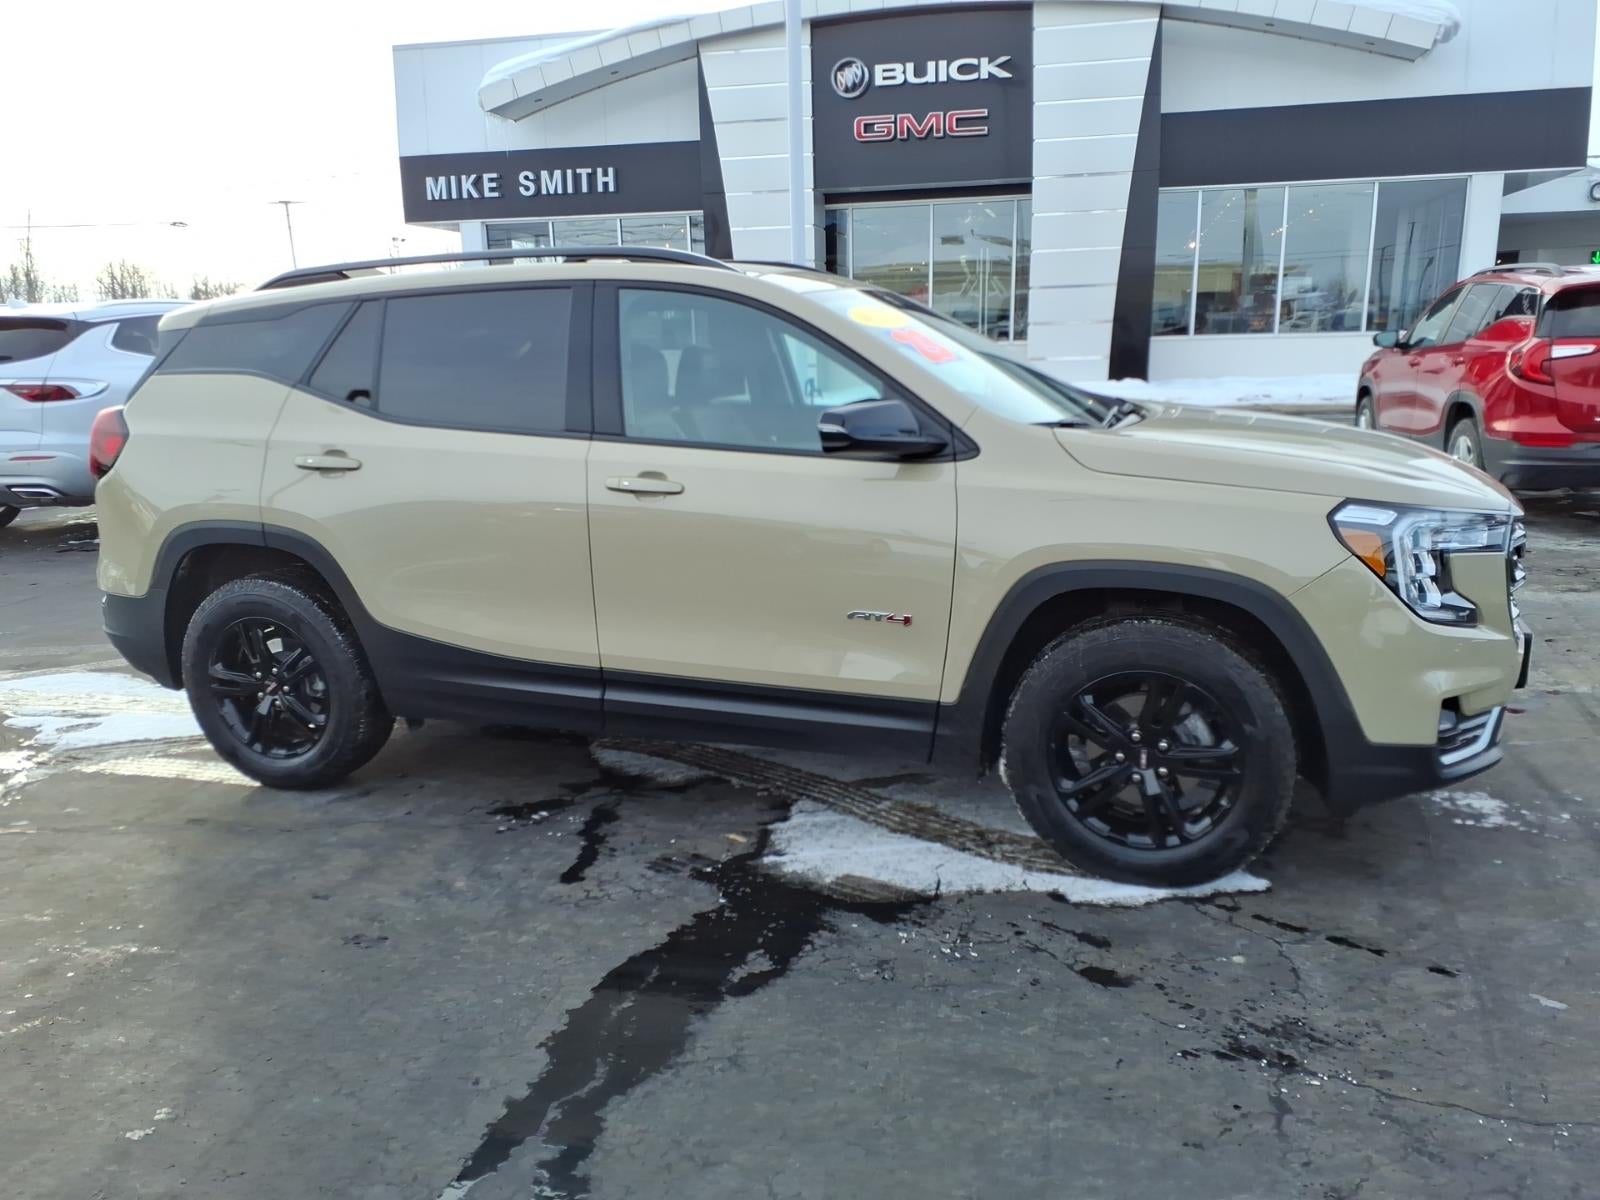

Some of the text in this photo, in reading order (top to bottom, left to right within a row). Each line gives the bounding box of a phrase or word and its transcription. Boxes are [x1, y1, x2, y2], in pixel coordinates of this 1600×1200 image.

[874, 55, 1013, 87] BUICK
[854, 108, 988, 142] GMC
[425, 166, 617, 201] MIKE SMITH
[846, 609, 913, 627] AT4
